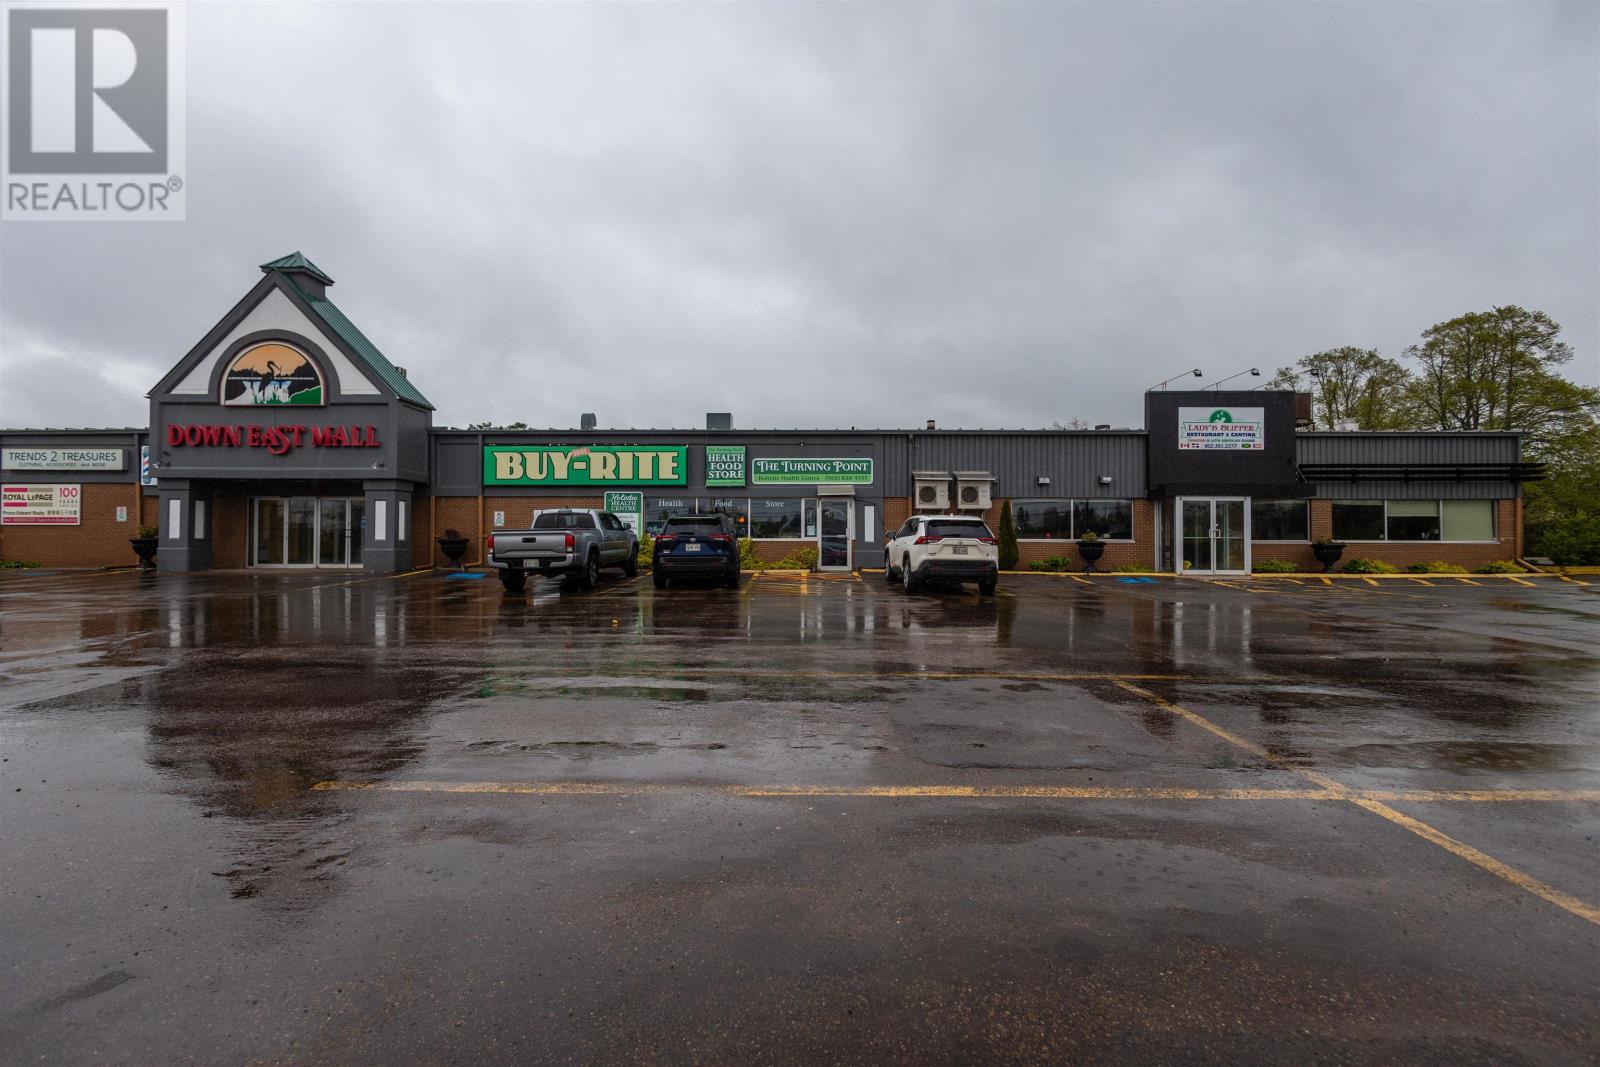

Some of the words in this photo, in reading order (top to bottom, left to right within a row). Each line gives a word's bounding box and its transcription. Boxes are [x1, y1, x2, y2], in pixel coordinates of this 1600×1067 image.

[167, 424, 242, 447] DOWN
[247, 424, 306, 455] EAST
[312, 424, 381, 447] MALL
[9, 452, 47, 461] TRENDS
[50, 451, 58, 462] 2
[61, 452, 117, 461] TREASURES
[493, 451, 680, 480] BUY-RITE
[710, 462, 742, 470] FOOD
[757, 461, 779, 472] THE
[781, 461, 831, 472] TURNING
[833, 461, 868, 472] POINT
[708, 470, 744, 478] STORE
[59, 487, 78, 498] 100
[608, 494, 638, 502] Holistic
